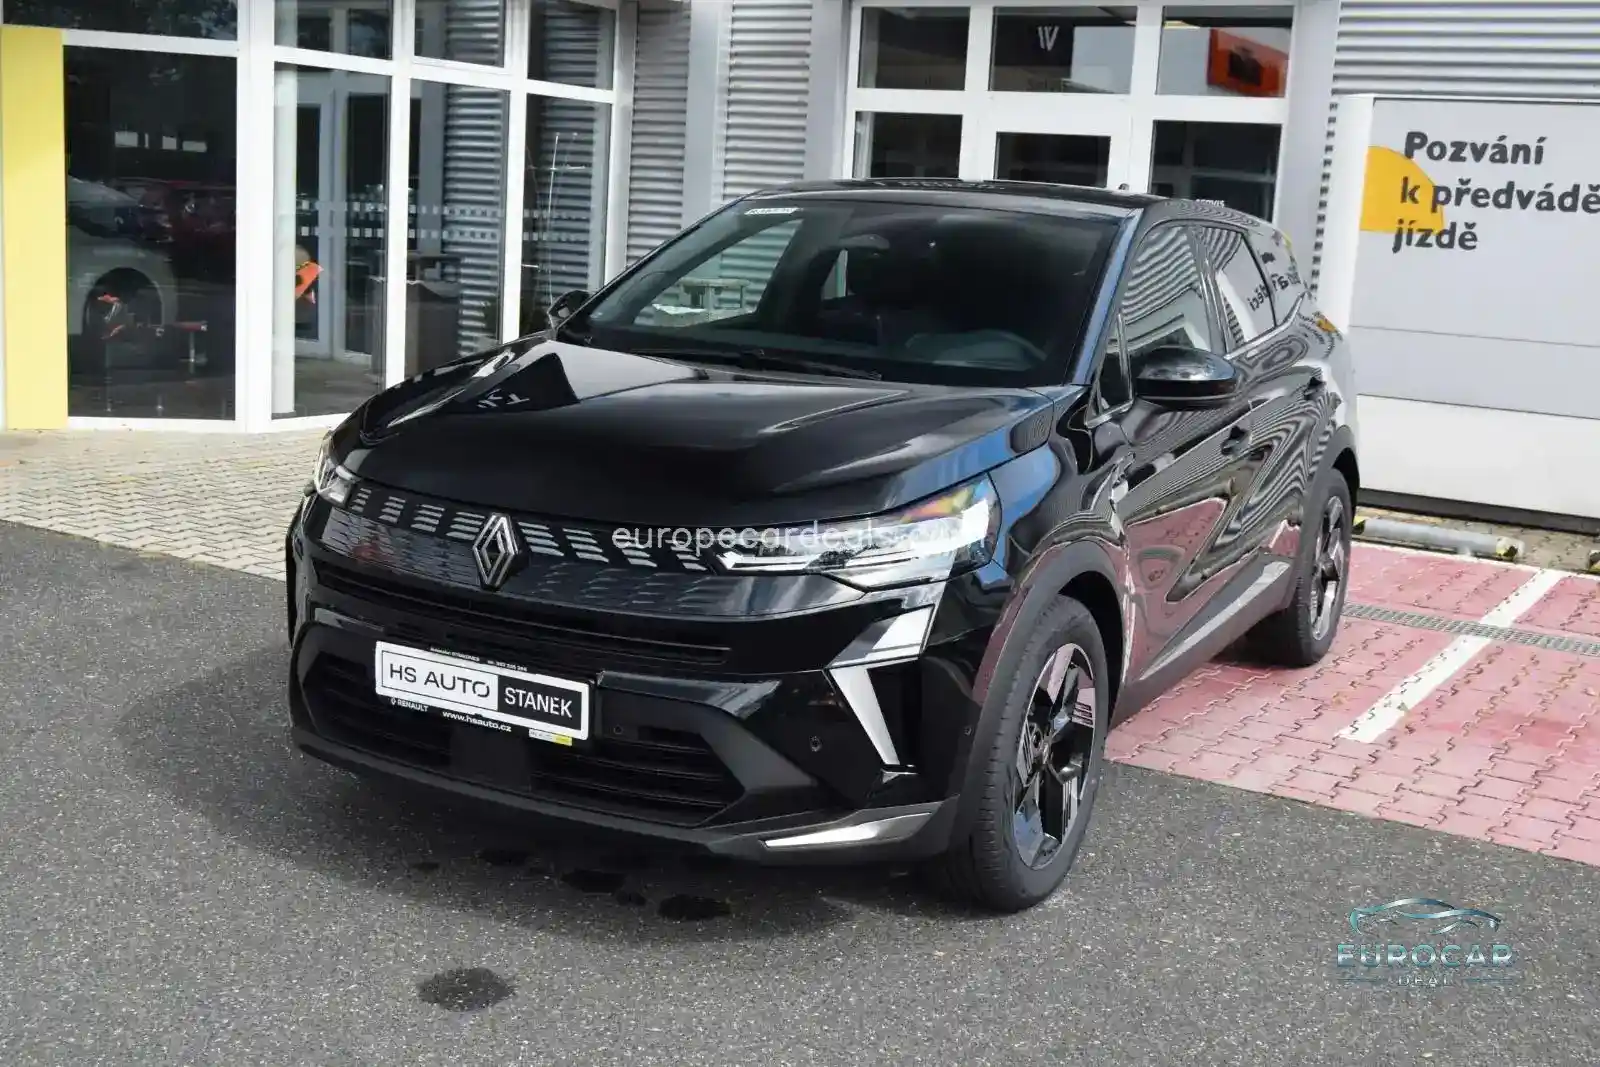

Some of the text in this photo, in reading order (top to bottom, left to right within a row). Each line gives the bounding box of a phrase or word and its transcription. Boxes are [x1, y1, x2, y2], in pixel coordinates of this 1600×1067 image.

[1404, 131, 1547, 165] Pozvání
[1400, 176, 1600, 214] k předvádě
[1392, 218, 1478, 254] jízdě
[389, 663, 417, 684] HS
[424, 670, 490, 699] AUTO
[397, 699, 429, 712] RENAULT
[442, 710, 512, 733] www.hsauto.cz
